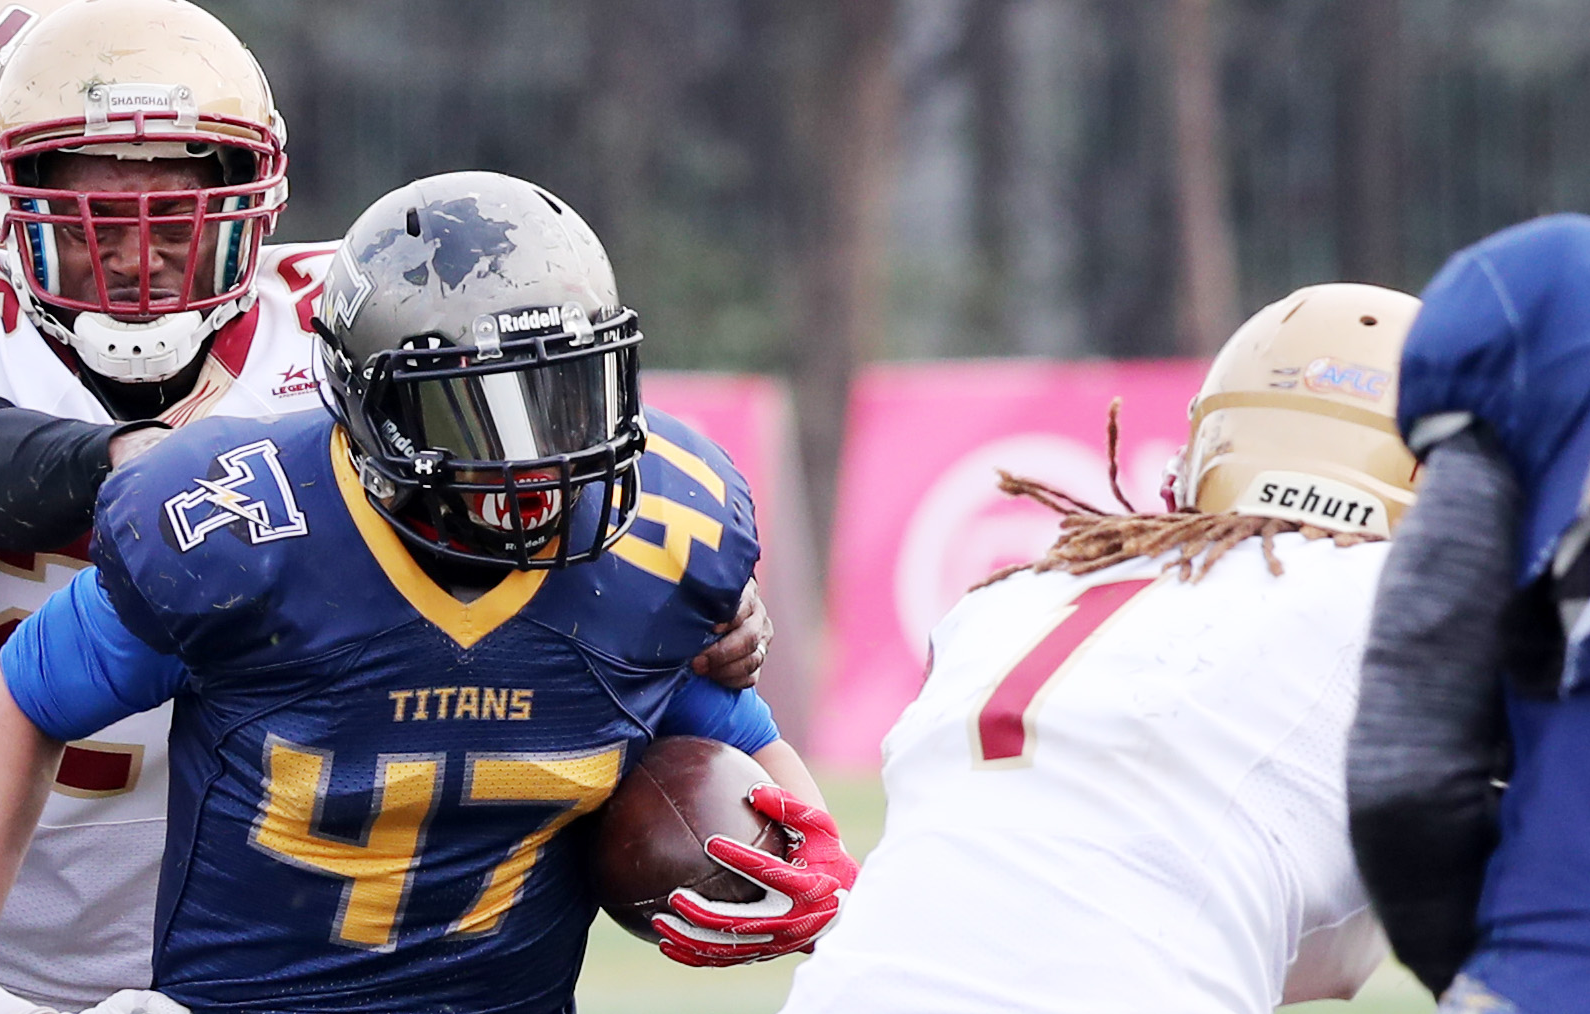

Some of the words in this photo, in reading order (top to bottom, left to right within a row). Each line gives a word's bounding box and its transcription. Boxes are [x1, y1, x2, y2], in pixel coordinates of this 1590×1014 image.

[110, 96, 169, 107] SHANGHAI
[498, 306, 560, 333] Riddell
[1259, 482, 1374, 528] schutt
[388, 686, 533, 722] TITANS
[248, 733, 628, 953] 47
